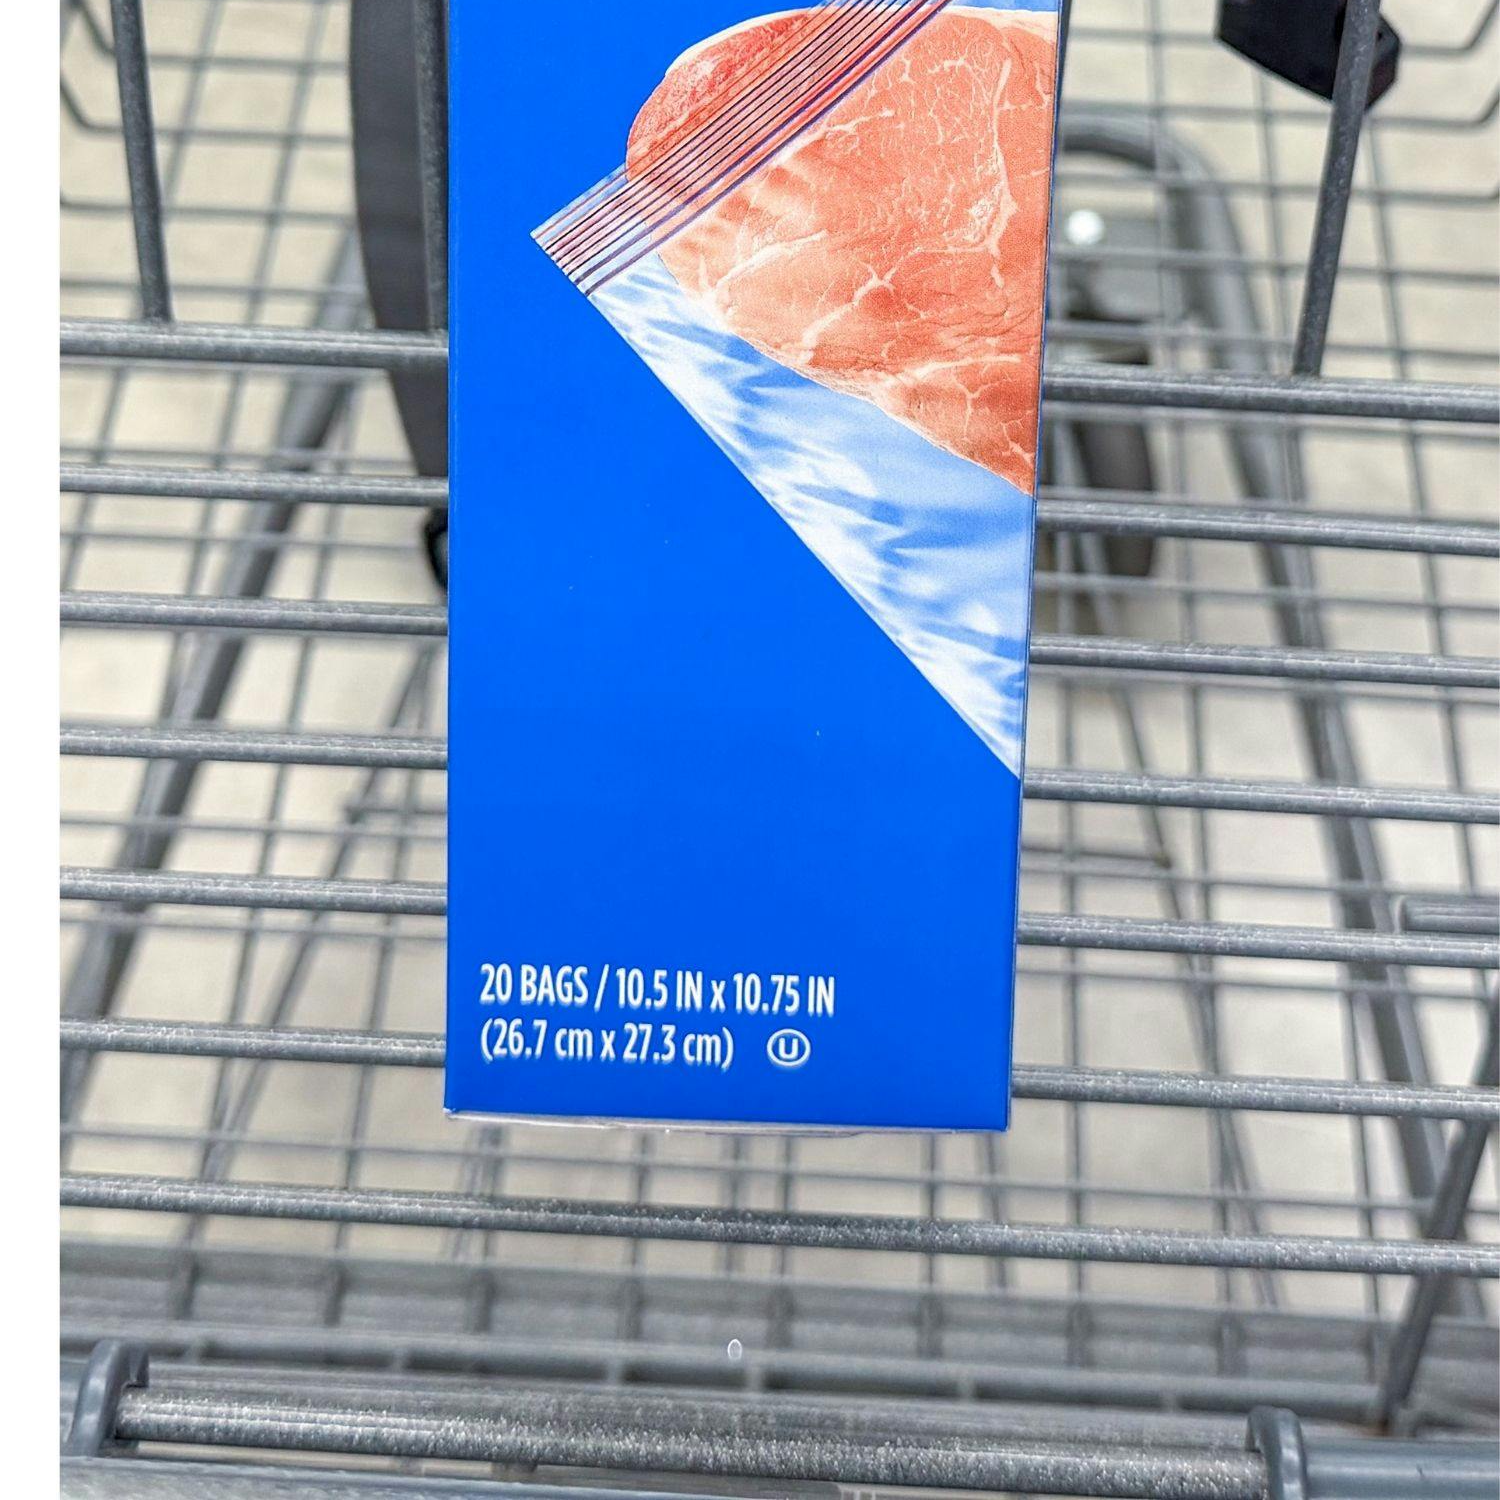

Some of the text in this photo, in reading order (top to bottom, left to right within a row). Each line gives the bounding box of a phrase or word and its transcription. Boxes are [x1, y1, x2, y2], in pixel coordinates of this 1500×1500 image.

[480, 964, 799, 1014] 20 BAGS 10.5 10.75
[481, 1018, 675, 1063] (26.7 27.3
